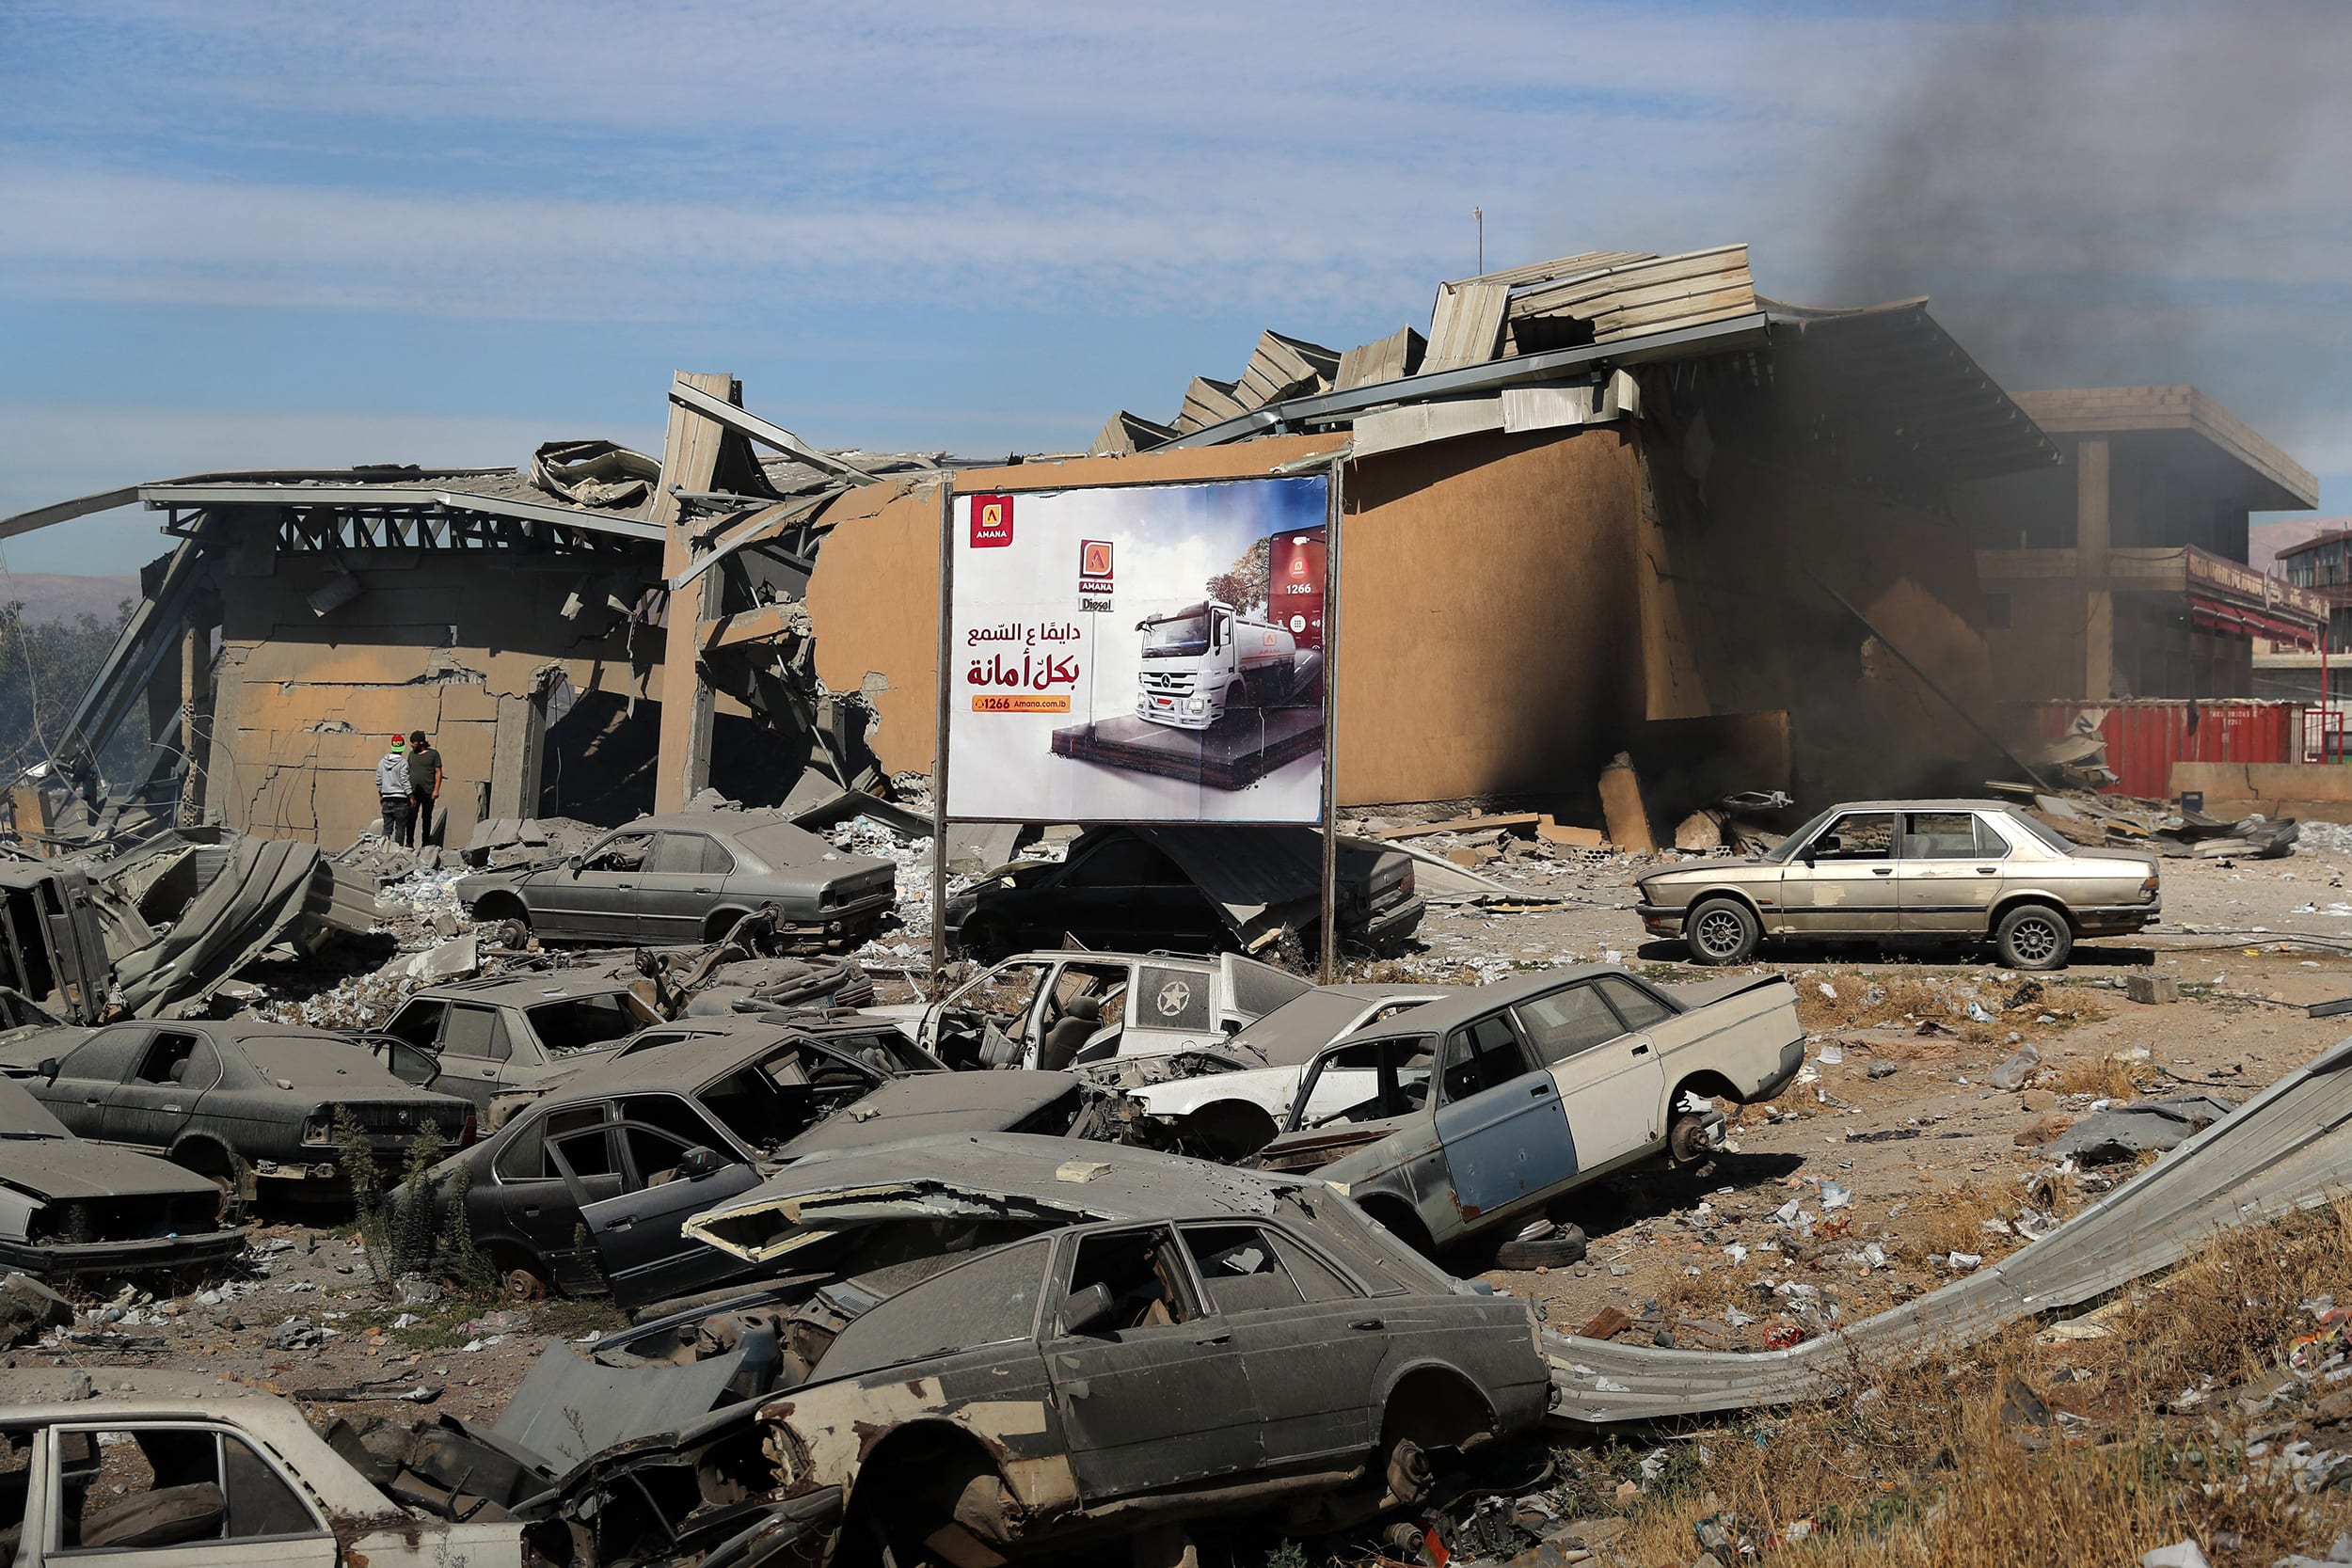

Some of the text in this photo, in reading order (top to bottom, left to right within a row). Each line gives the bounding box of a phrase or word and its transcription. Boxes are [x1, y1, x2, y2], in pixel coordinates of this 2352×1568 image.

[976, 531, 1008, 539] AMANA
[1082, 582, 1113, 592] AMANA
[1286, 583, 1311, 594] 1266
[1083, 598, 1111, 610] Diesel
[1025, 627, 1036, 646] ع
[967, 647, 1030, 688] أمانة
[984, 698, 1067, 709] 1266 Amana.com.lb
